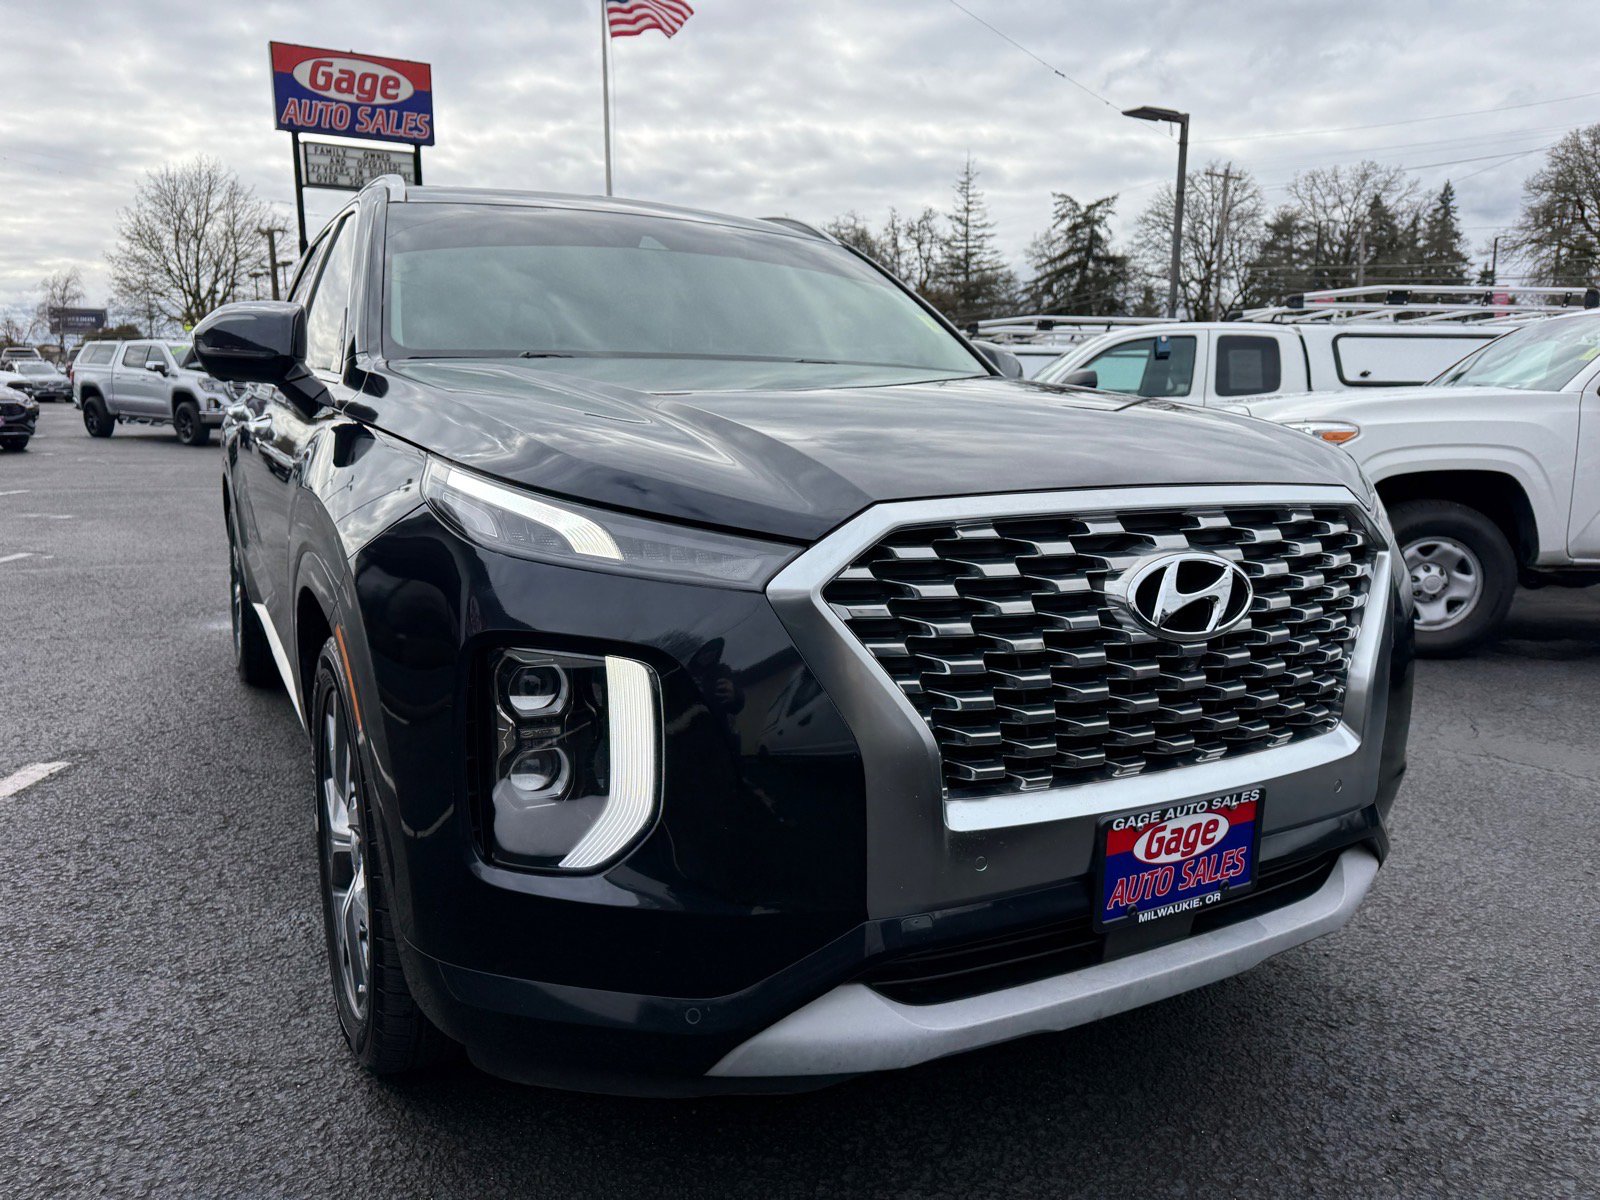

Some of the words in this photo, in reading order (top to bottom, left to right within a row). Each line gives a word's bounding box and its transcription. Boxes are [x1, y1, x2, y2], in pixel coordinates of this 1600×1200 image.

[308, 60, 401, 103] Gage
[281, 97, 351, 130] AUTO
[356, 106, 430, 139] SALES
[311, 164, 320, 173] 27
[324, 165, 350, 176] YEARS
[355, 167, 363, 176] IN
[314, 146, 347, 157] FAMILY
[363, 151, 391, 162] OWNED
[330, 157, 346, 166] AND
[316, 173, 339, 184] OVER
[1112, 811, 1161, 831] GAGE
[1164, 801, 1208, 820] AUTO
[1211, 789, 1260, 809] SALES
[1144, 818, 1219, 860] Gage
[1107, 865, 1174, 910] AUTO
[1178, 846, 1247, 891] SALES
[1138, 897, 1203, 923] MILWAUKIE,
[1205, 893, 1221, 905] OR
